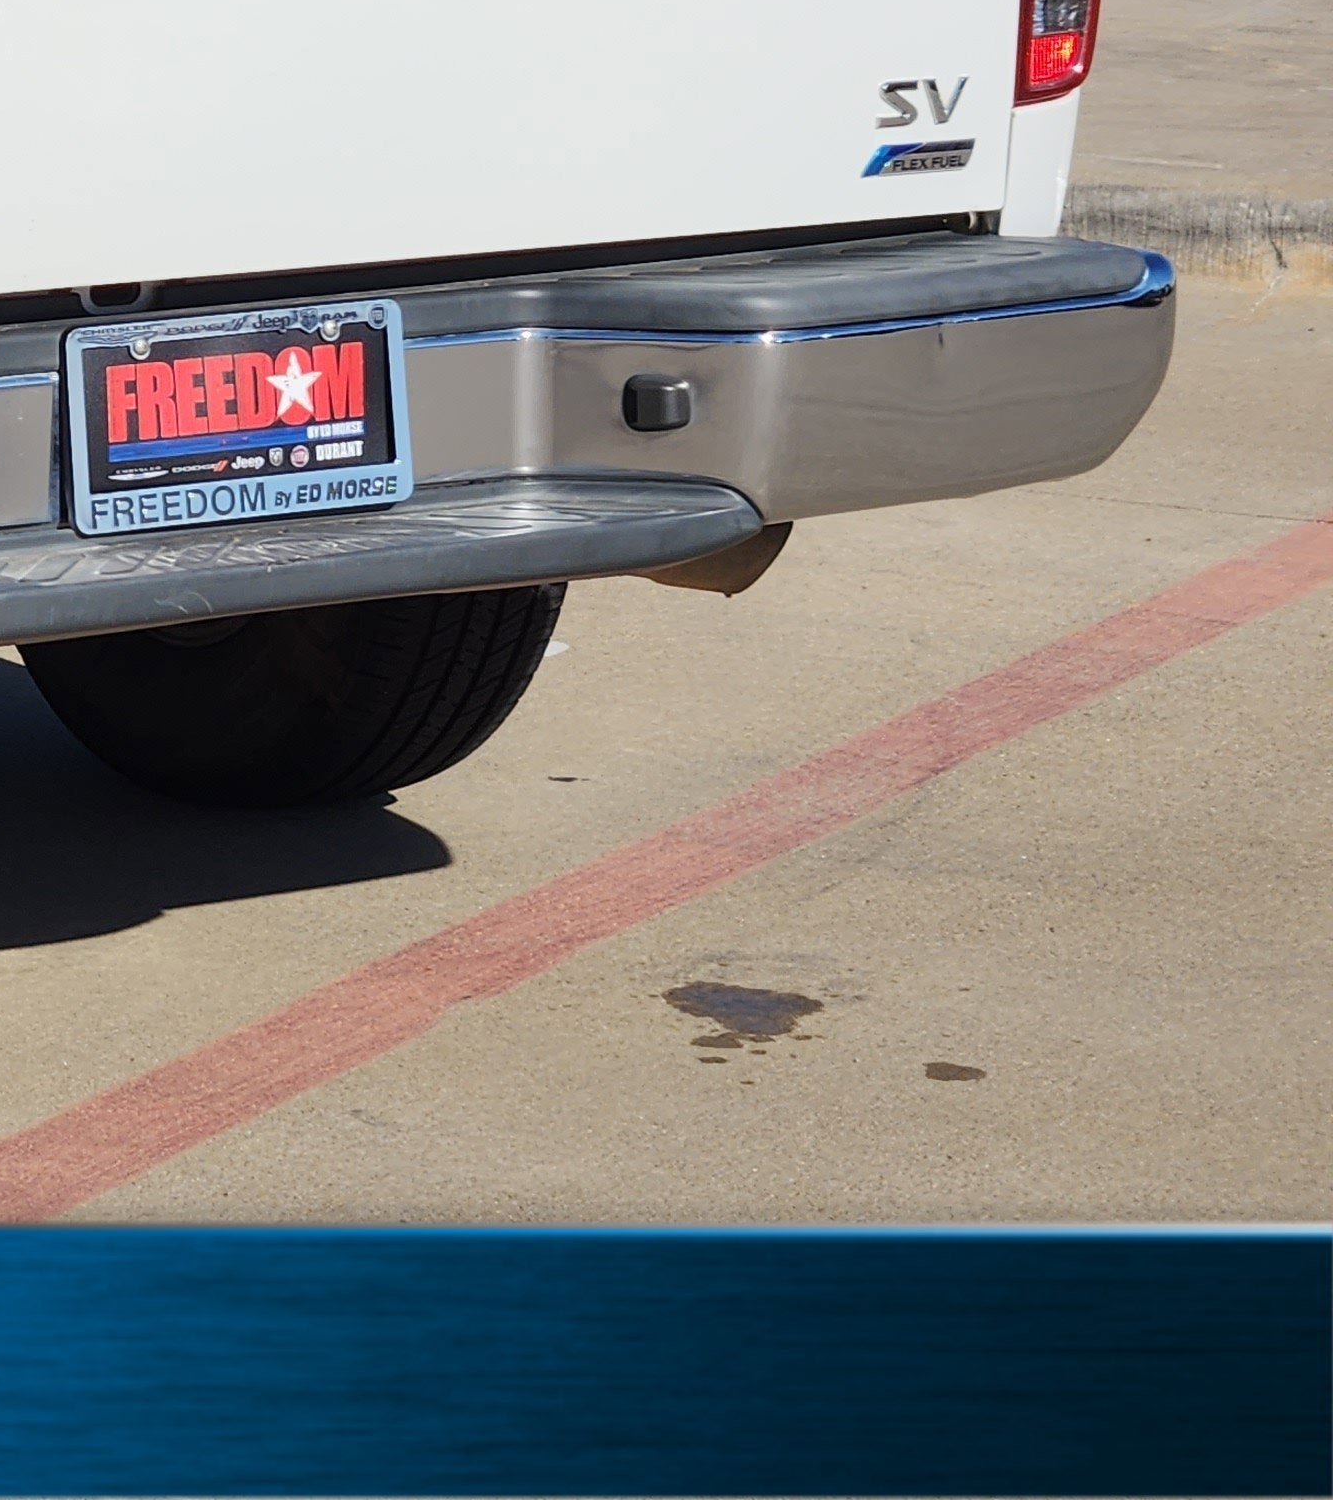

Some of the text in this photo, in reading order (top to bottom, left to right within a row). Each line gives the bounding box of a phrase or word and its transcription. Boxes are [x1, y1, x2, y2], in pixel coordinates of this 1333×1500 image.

[875, 74, 970, 129] SV
[892, 155, 967, 171] FLEX FUEL
[253, 314, 291, 332] Jeep
[105, 341, 365, 443] FREEDOM
[231, 454, 265, 470] Jeep
[315, 441, 364, 461] DURANT
[90, 481, 266, 530] FREEDOM
[295, 484, 322, 505] ED
[326, 475, 398, 501] MORSE
